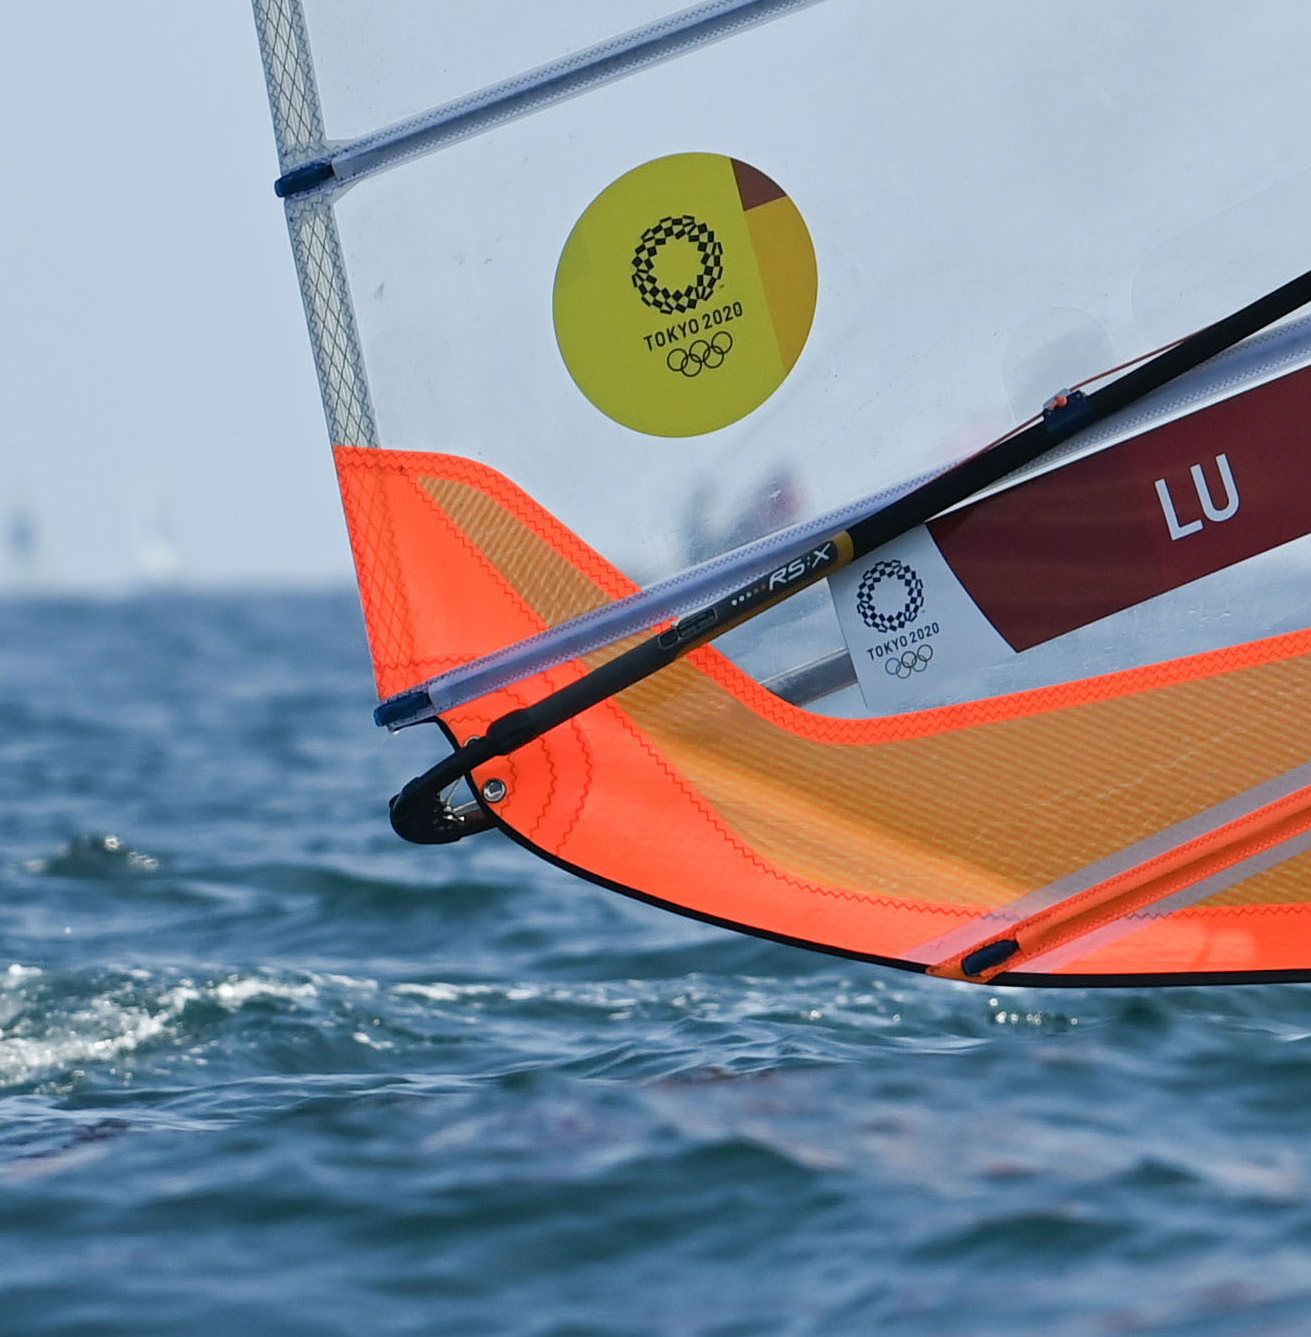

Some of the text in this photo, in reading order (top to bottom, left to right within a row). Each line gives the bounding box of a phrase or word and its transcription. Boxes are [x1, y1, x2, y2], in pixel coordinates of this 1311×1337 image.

[643, 301, 743, 351] TOKYO 2020
[1154, 453, 1241, 542] LU
[768, 543, 832, 591] RS:X
[867, 622, 940, 661] TOKYO 2020
